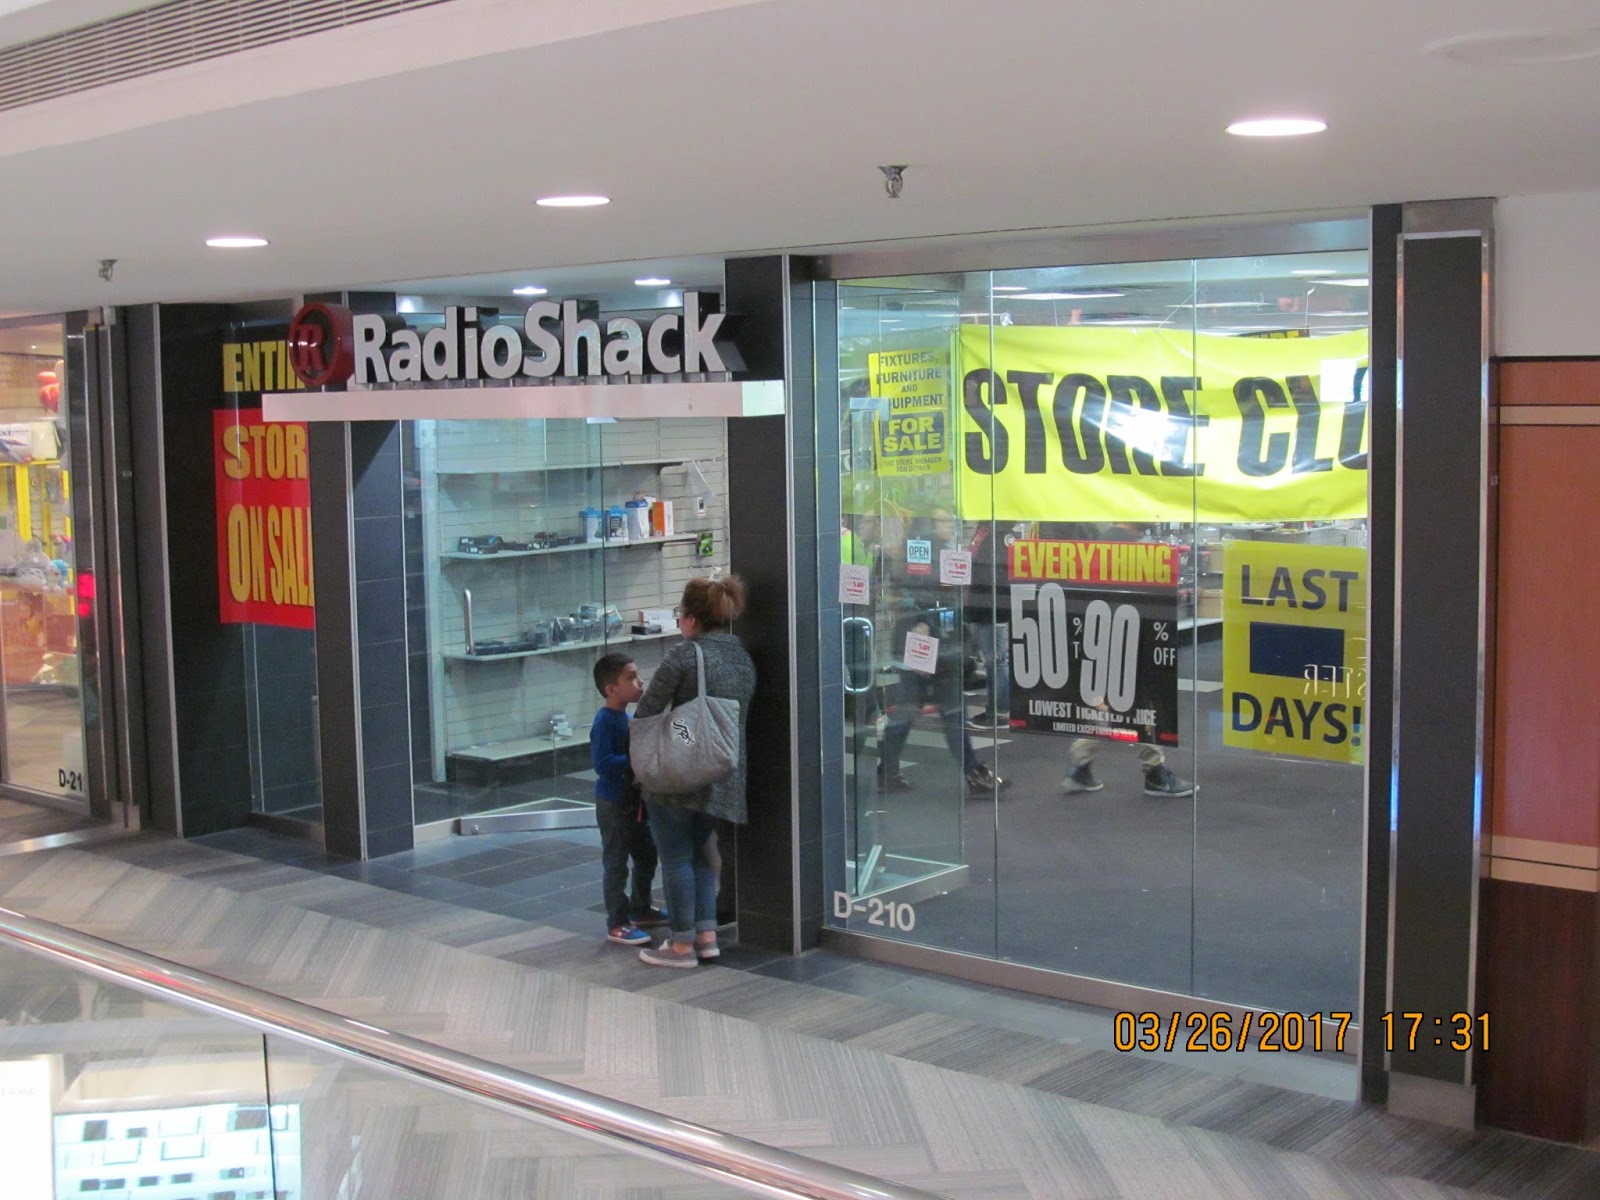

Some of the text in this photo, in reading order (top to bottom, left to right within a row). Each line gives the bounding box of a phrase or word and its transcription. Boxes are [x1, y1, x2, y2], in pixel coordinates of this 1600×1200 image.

[353, 292, 727, 384] RadioShack
[876, 369, 942, 385] FURNITURE
[901, 385, 918, 393] AND
[891, 394, 944, 409] UIPMENT
[888, 416, 934, 435] FOR
[963, 367, 1210, 477] STORE
[883, 433, 941, 453] SALE
[227, 504, 266, 603] ON
[909, 546, 929, 557] OPEN
[1014, 541, 1171, 584] EVERYTHING
[1241, 564, 1359, 613] LAST
[1010, 582, 1069, 690] 50
[1153, 621, 1170, 642] %
[1079, 599, 1140, 713] 90
[1153, 646, 1177, 667] OFF
[1028, 699, 1072, 719] LOWEST
[1231, 691, 1362, 748] DAYS!
[834, 890, 916, 932] D-210
